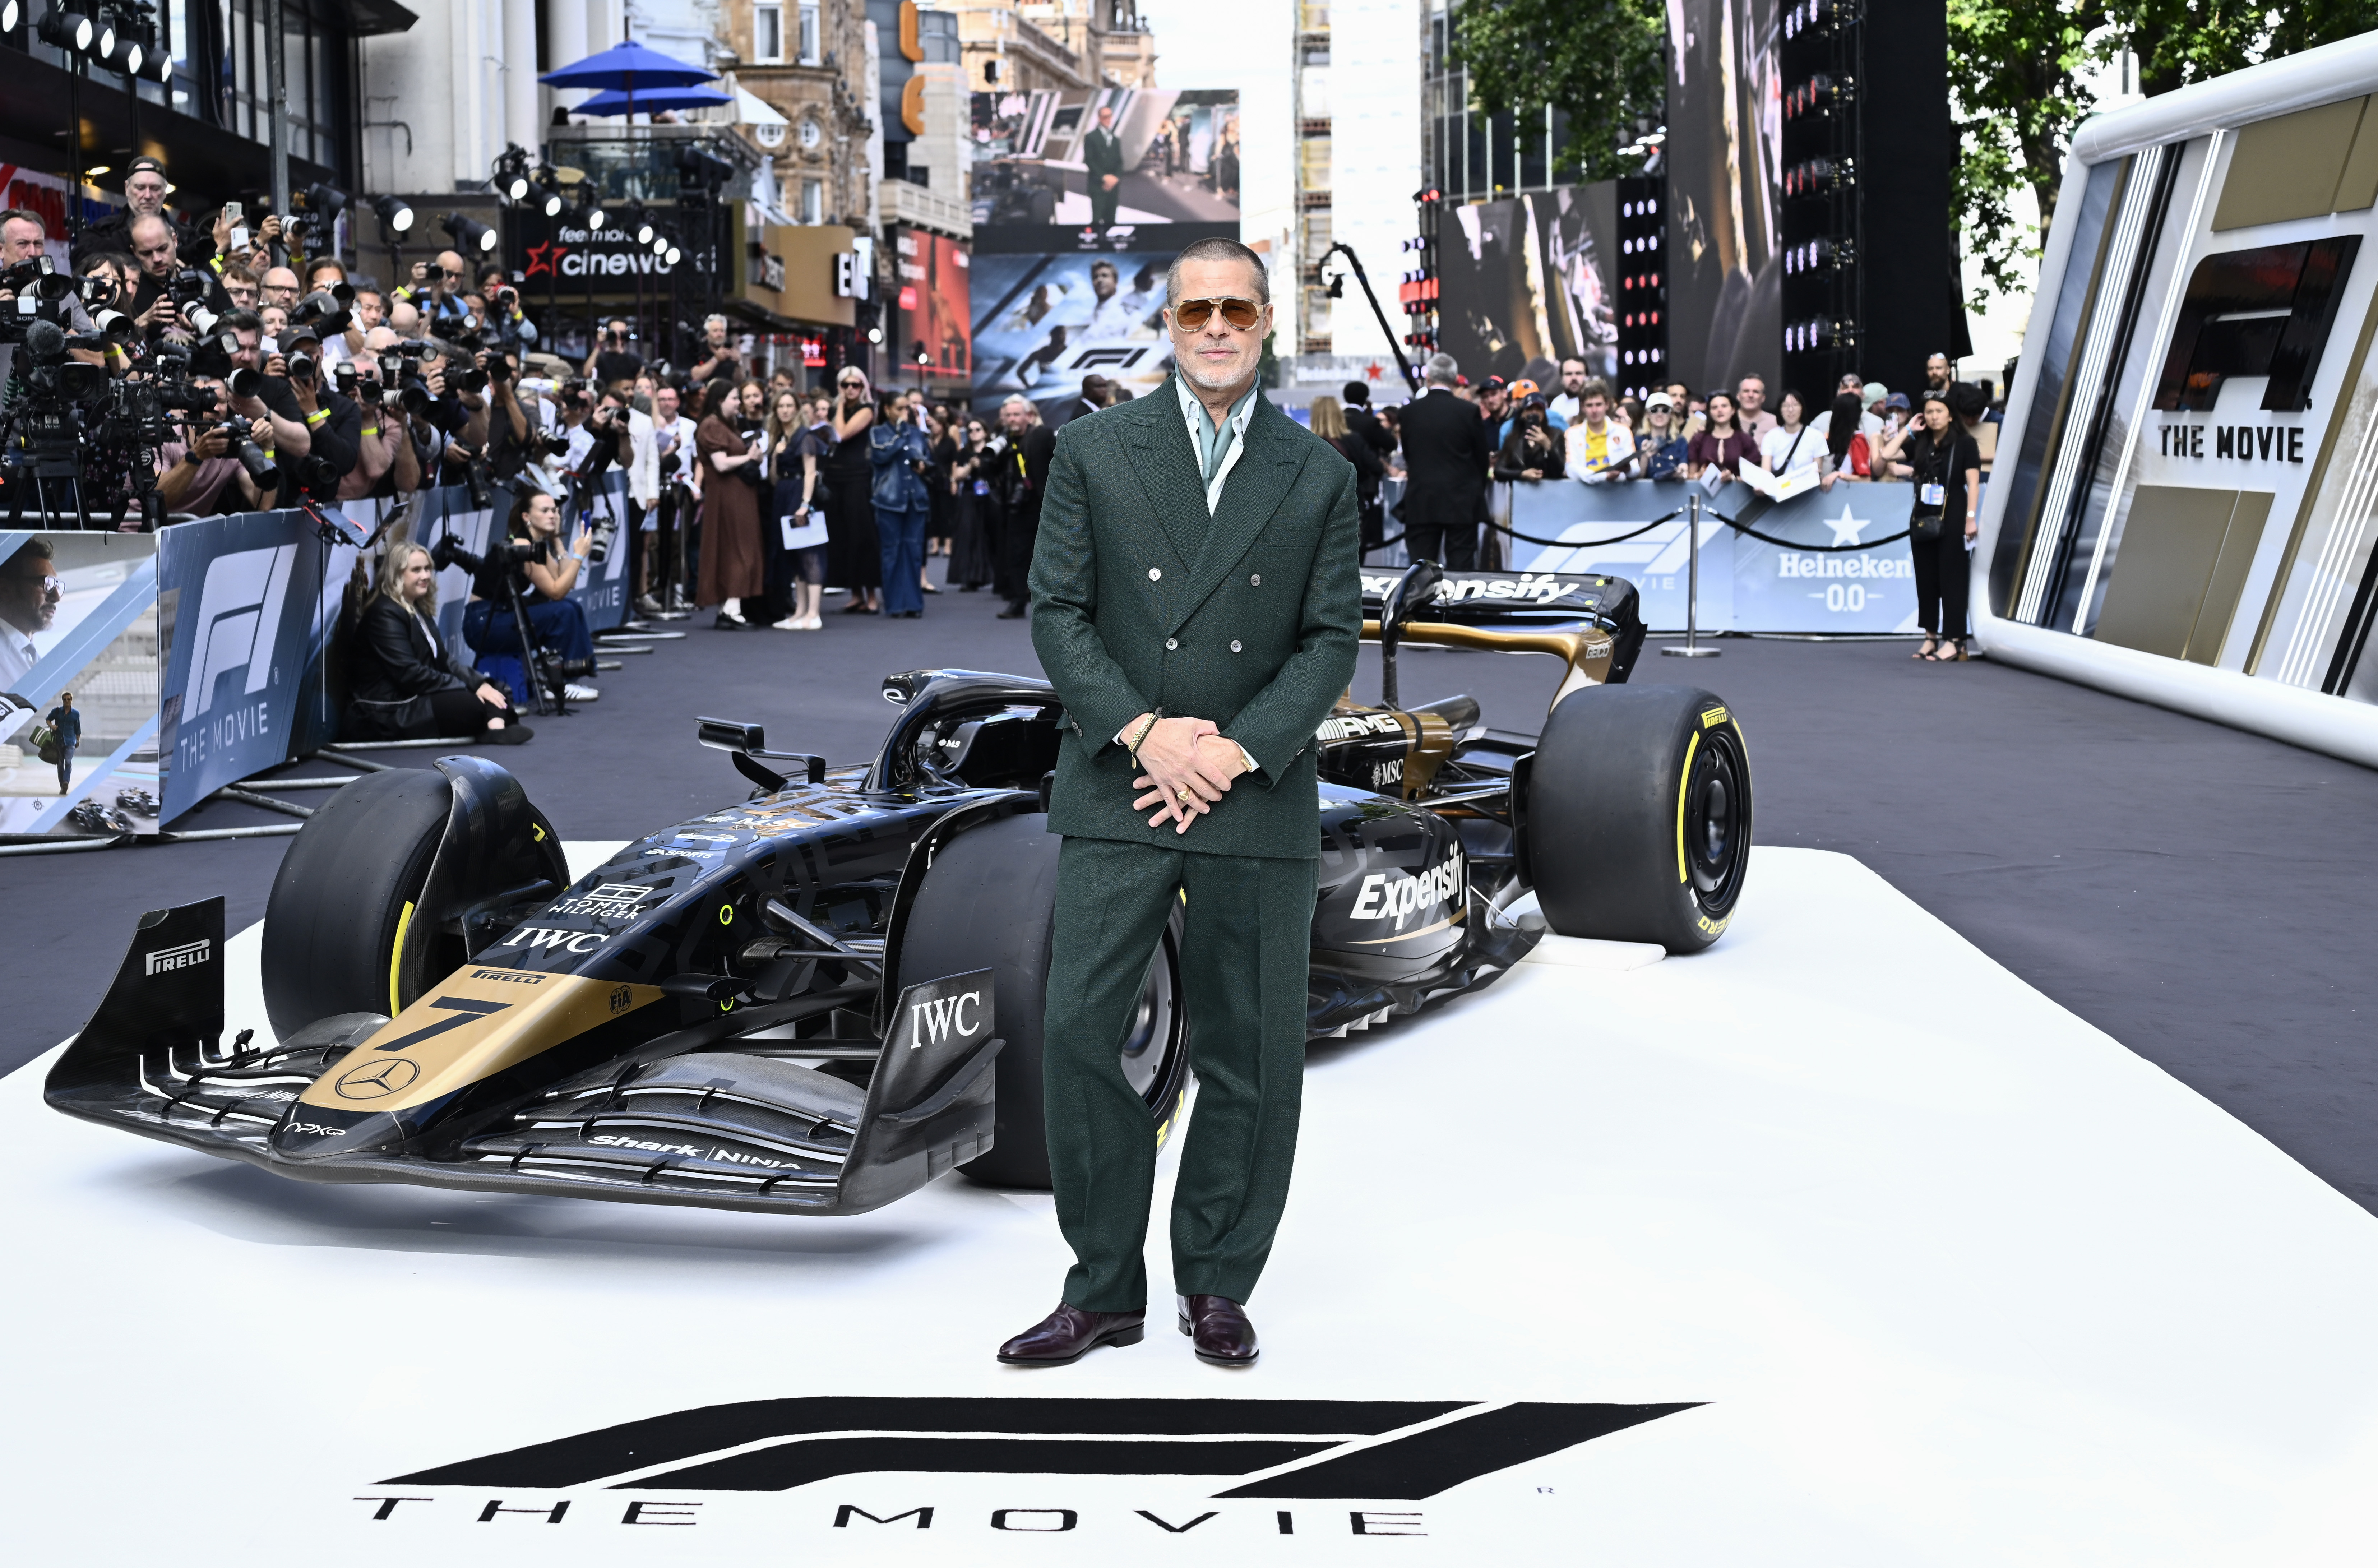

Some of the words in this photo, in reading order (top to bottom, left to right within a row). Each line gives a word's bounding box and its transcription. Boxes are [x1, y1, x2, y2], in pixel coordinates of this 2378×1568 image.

[2158, 425, 2204, 458] THE
[2217, 426, 2304, 463] MOVIE
[1778, 552, 1913, 578] Heineken
[1826, 583, 1865, 612] 0.0
[1585, 644, 1611, 660] GEICO
[1336, 714, 1402, 738] AMG
[1701, 706, 1727, 729] PIRELLI
[181, 736, 206, 772] THE
[213, 702, 269, 753] MOVIE
[1382, 758, 1404, 786] MSC
[731, 817, 824, 828] MSC
[675, 833, 739, 842] GEICO
[665, 850, 714, 859] SPORTS
[1349, 840, 1463, 930] Expensify
[548, 905, 638, 920] HILFIGER
[564, 898, 647, 912] TOMMY
[502, 927, 610, 953] IWC
[145, 938, 210, 976] PIRELLI
[469, 969, 547, 985] PIRELLI
[372, 996, 514, 1052] 7
[911, 991, 980, 1049] IWC
[588, 1135, 705, 1157] Shark
[713, 1149, 802, 1170] NINJA
[353, 1498, 703, 1525] THE
[833, 1505, 1428, 1535] MOVIE
